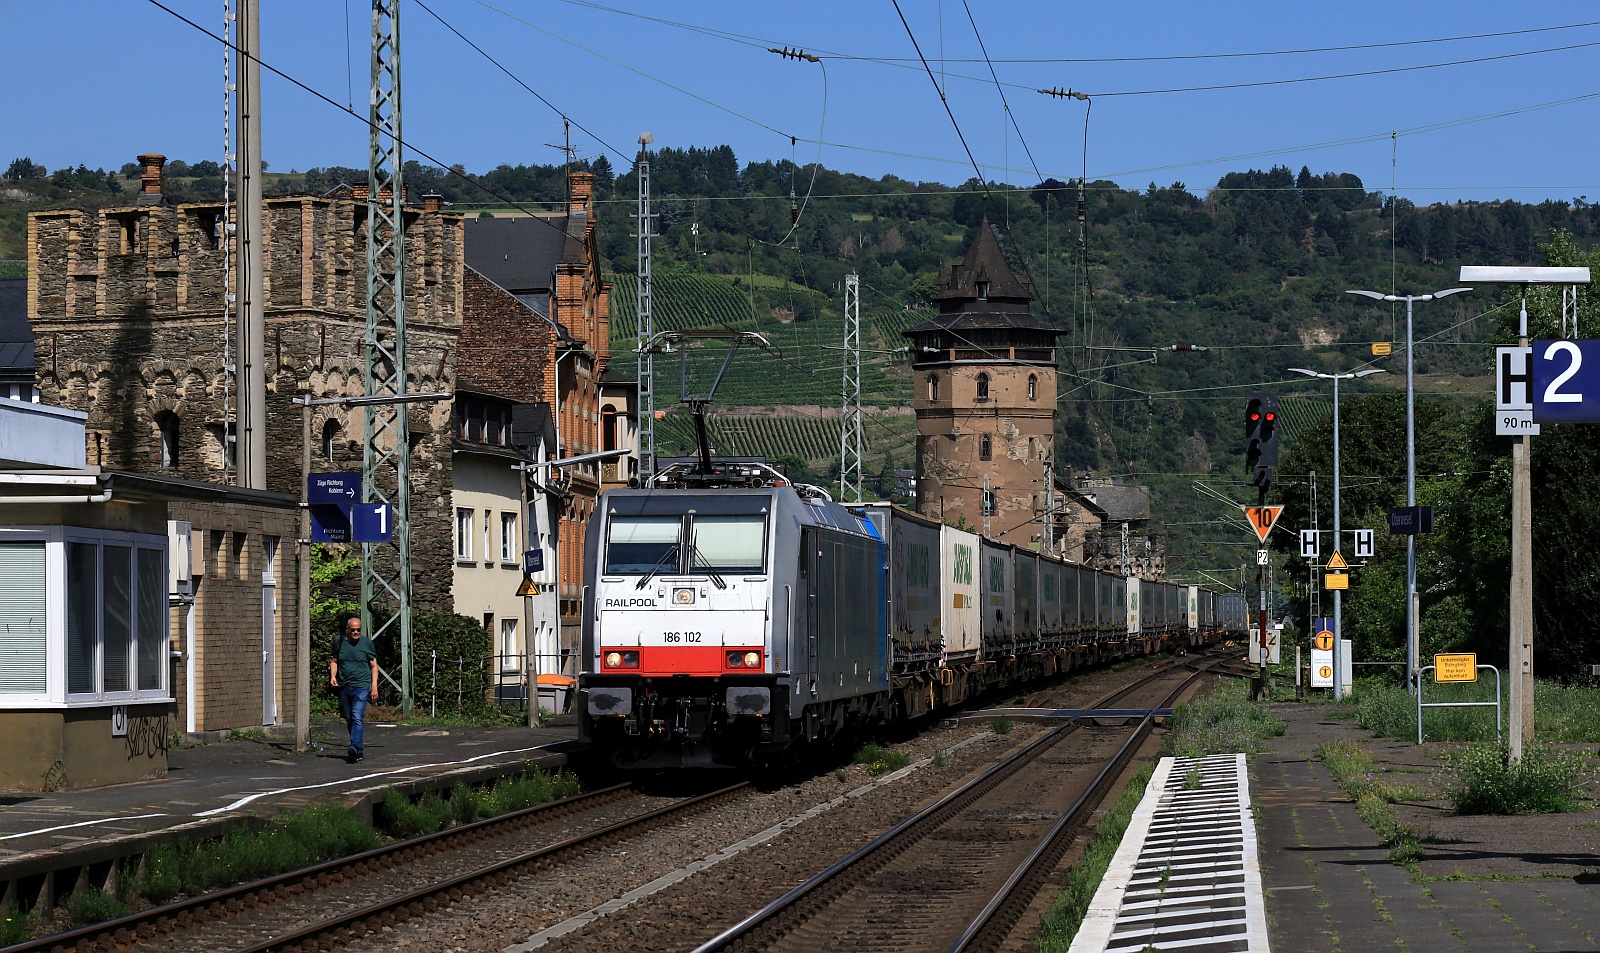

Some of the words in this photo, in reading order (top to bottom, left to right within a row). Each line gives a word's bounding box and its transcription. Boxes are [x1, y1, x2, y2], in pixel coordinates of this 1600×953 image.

[1502, 353, 1533, 404] H
[1543, 341, 1583, 403] 2
[1503, 417, 1518, 428] 90
[1520, 420, 1532, 428] m
[326, 479, 344, 487] Richtung
[374, 504, 386, 534] 1
[1254, 508, 1272, 528] 10
[1302, 532, 1317, 554] H
[1357, 532, 1372, 554] H
[1257, 552, 1268, 563] P2
[605, 598, 658, 607] RAILPOOL
[662, 632, 680, 642] 186
[684, 632, 702, 642] 102
